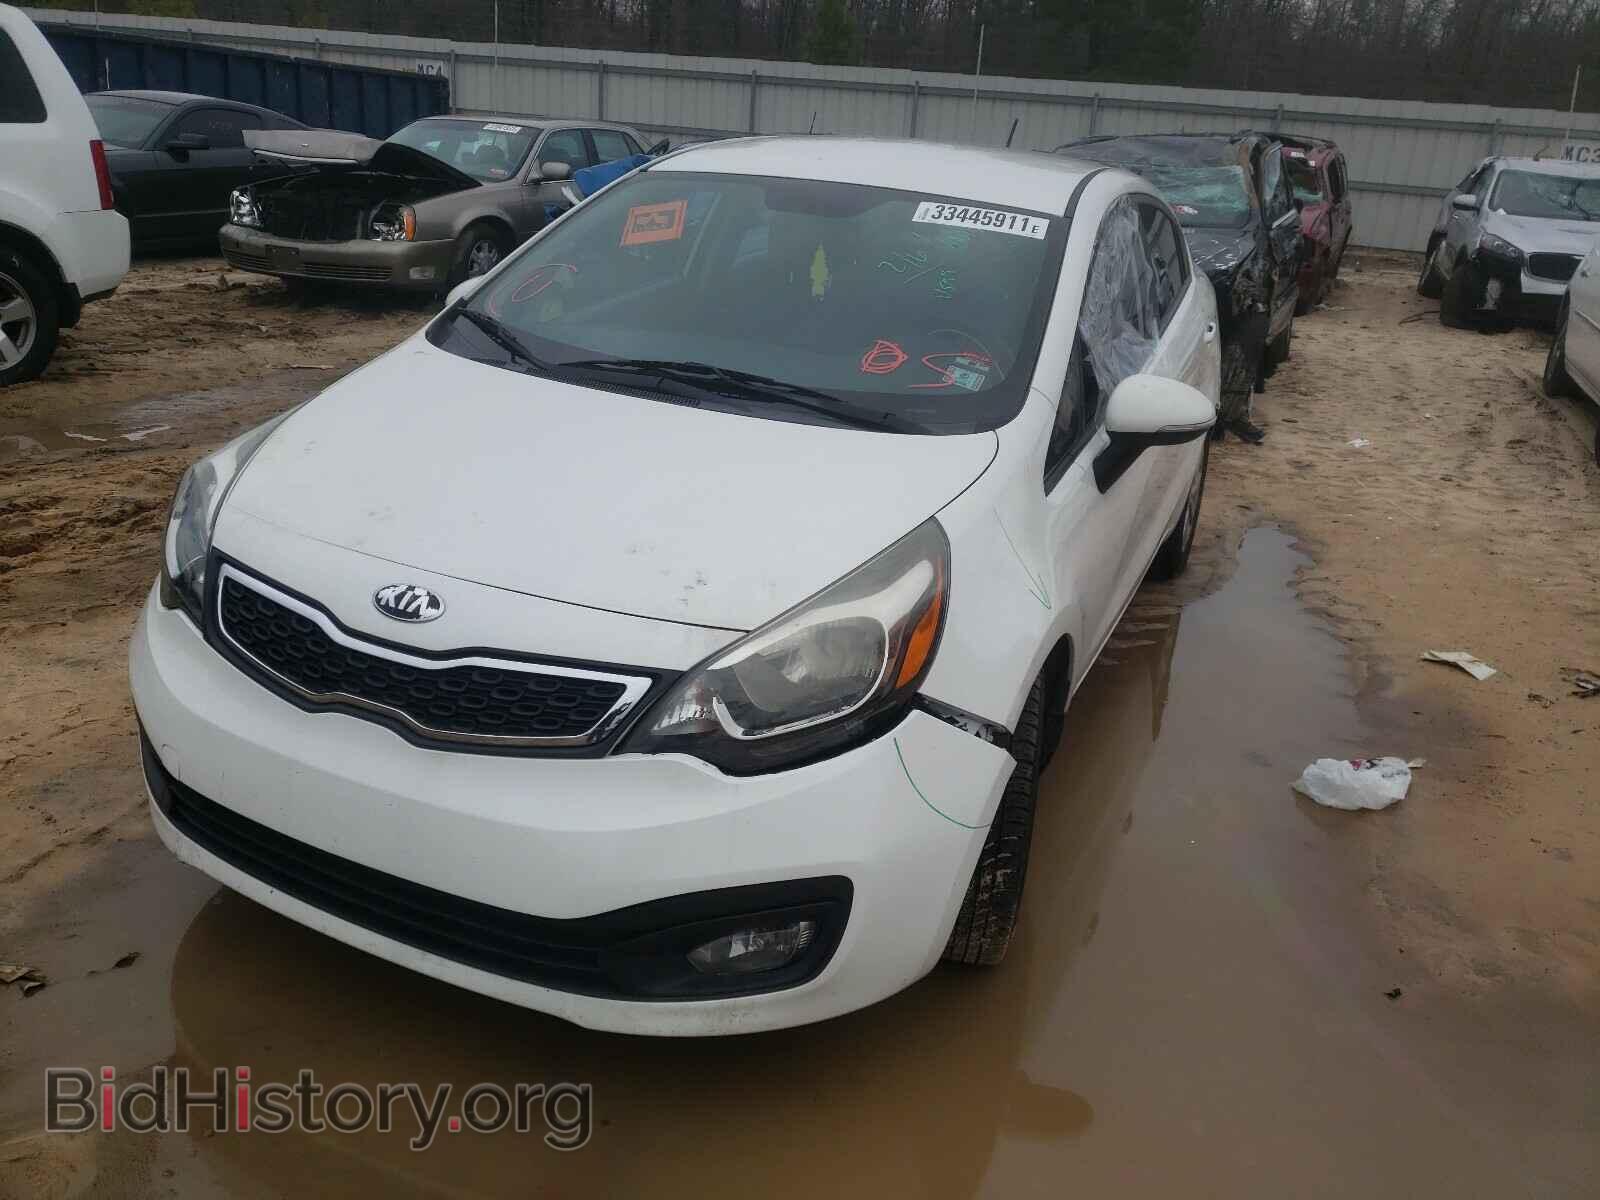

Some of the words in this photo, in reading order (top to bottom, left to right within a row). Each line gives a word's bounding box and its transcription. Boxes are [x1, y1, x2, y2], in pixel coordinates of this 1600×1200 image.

[930, 204, 1030, 232] 33445911
[1031, 225, 1040, 234] E
[377, 584, 430, 616] KIA
